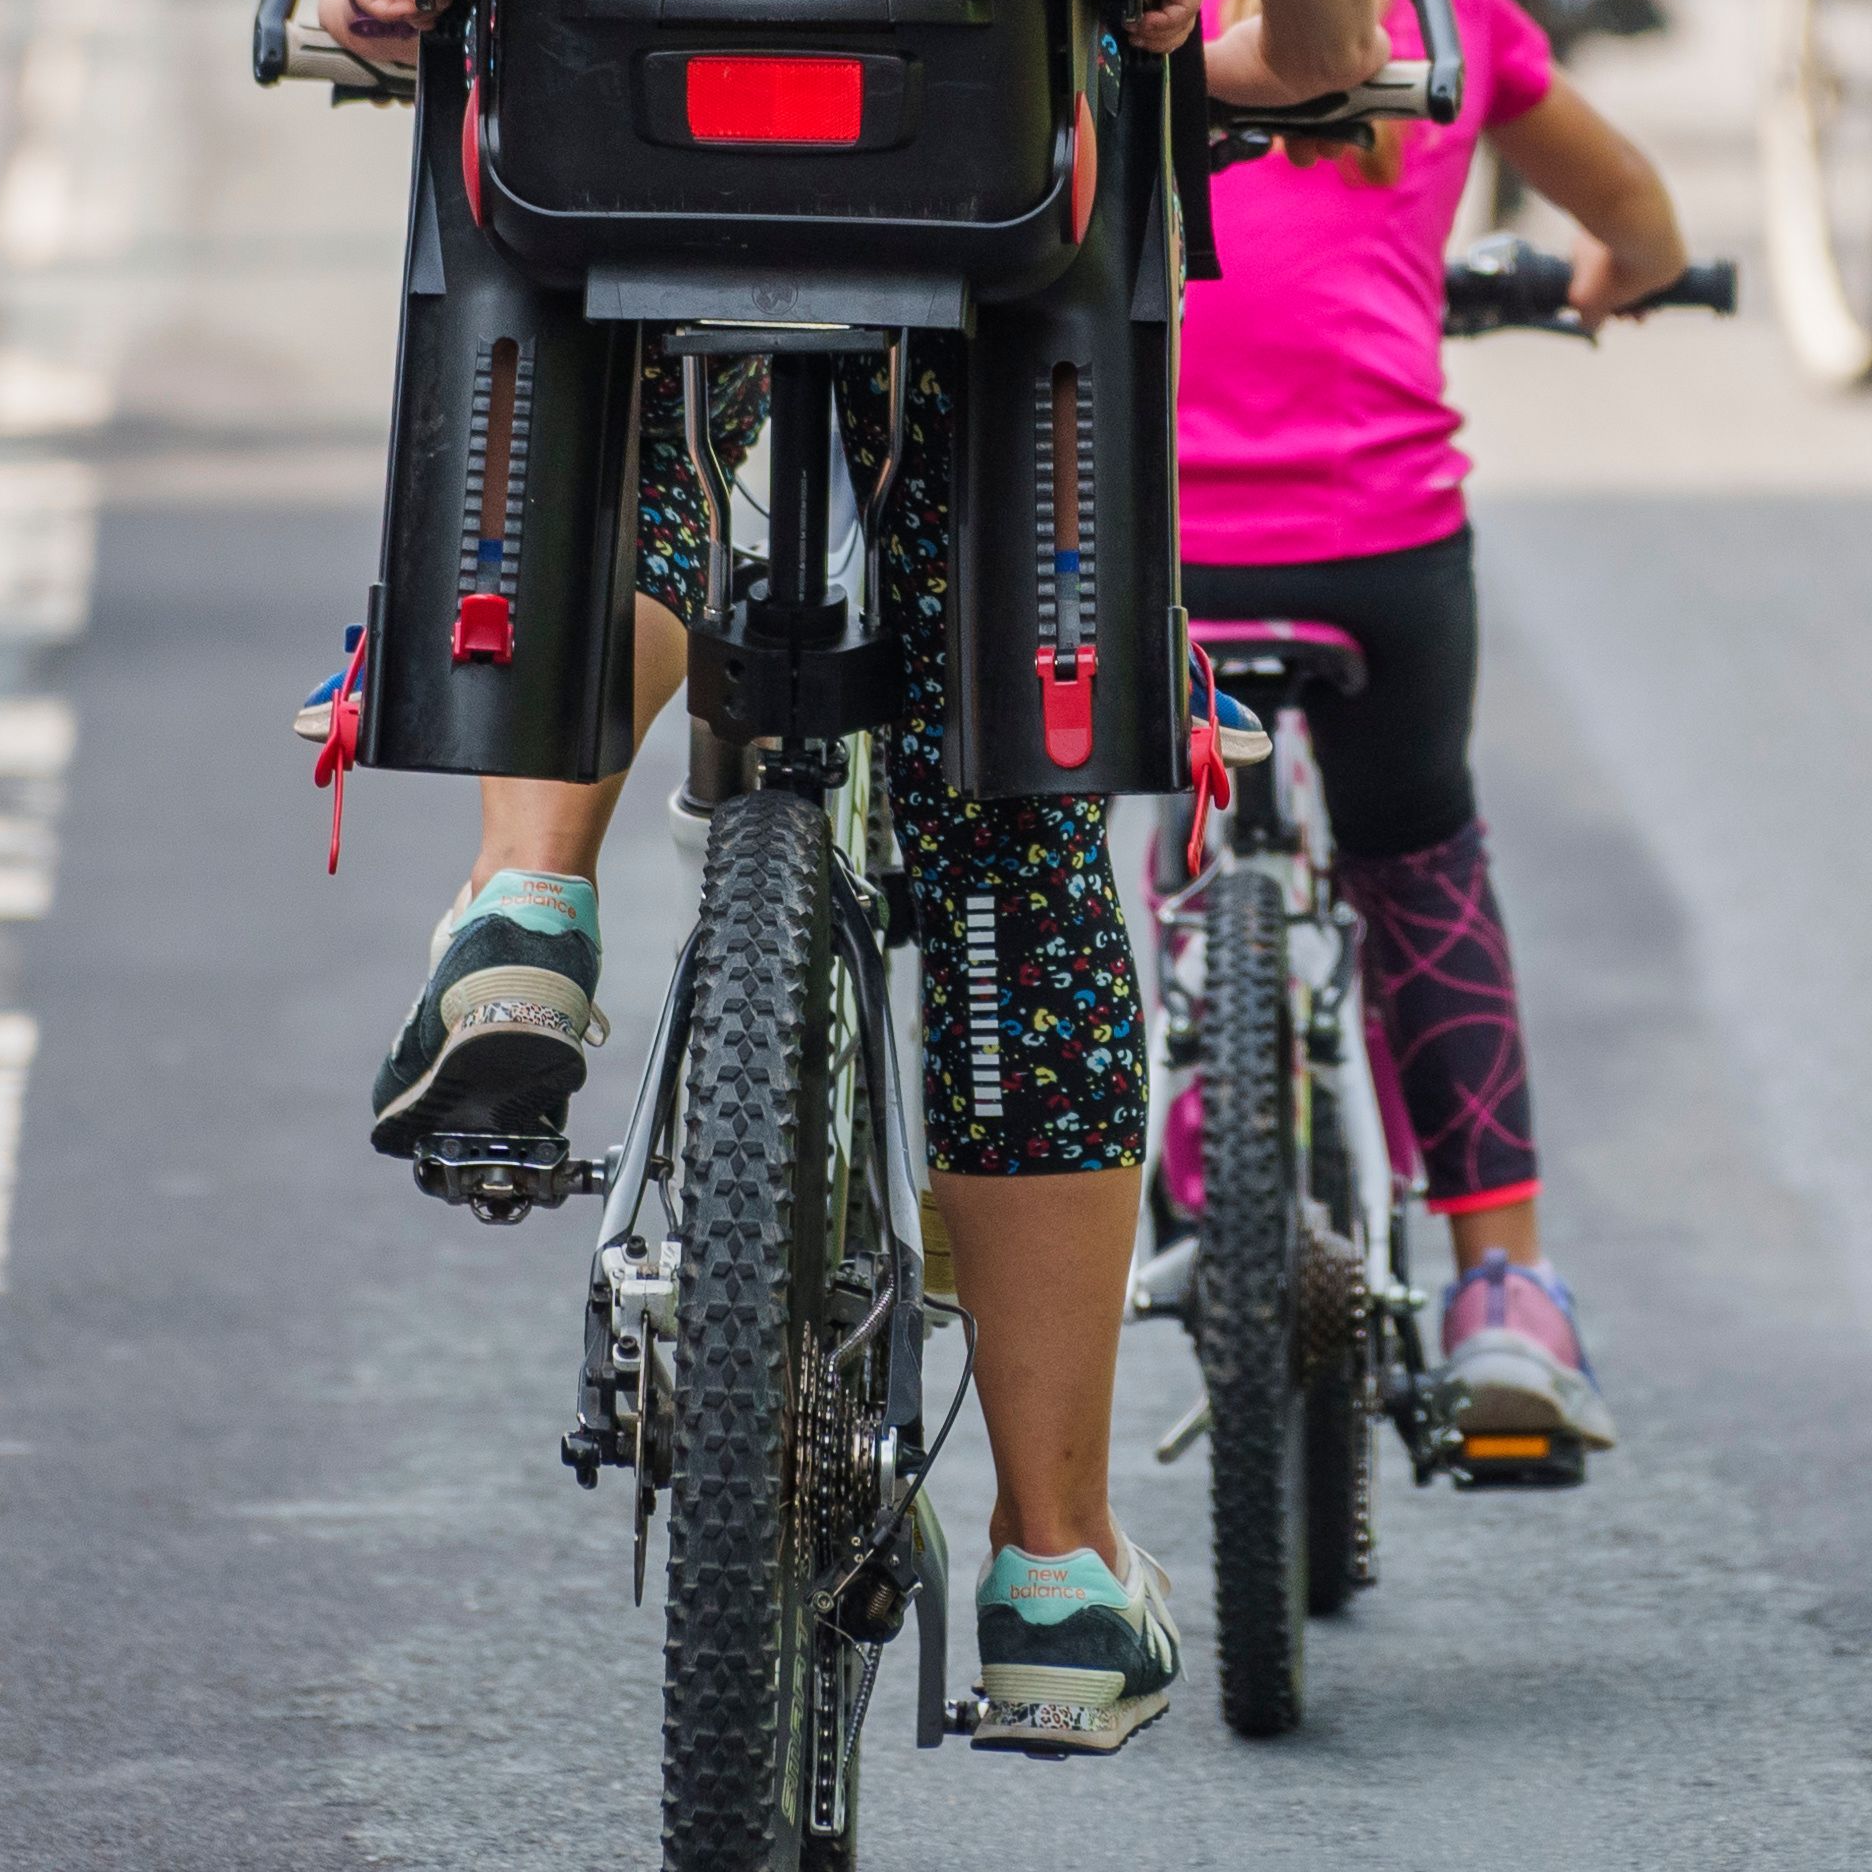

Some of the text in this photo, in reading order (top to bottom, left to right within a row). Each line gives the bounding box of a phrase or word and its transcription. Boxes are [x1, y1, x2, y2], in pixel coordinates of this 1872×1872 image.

[523, 880, 564, 895] new
[501, 893, 577, 920] balance
[1027, 1568, 1068, 1582] new
[1010, 1582, 1087, 1601] balance
